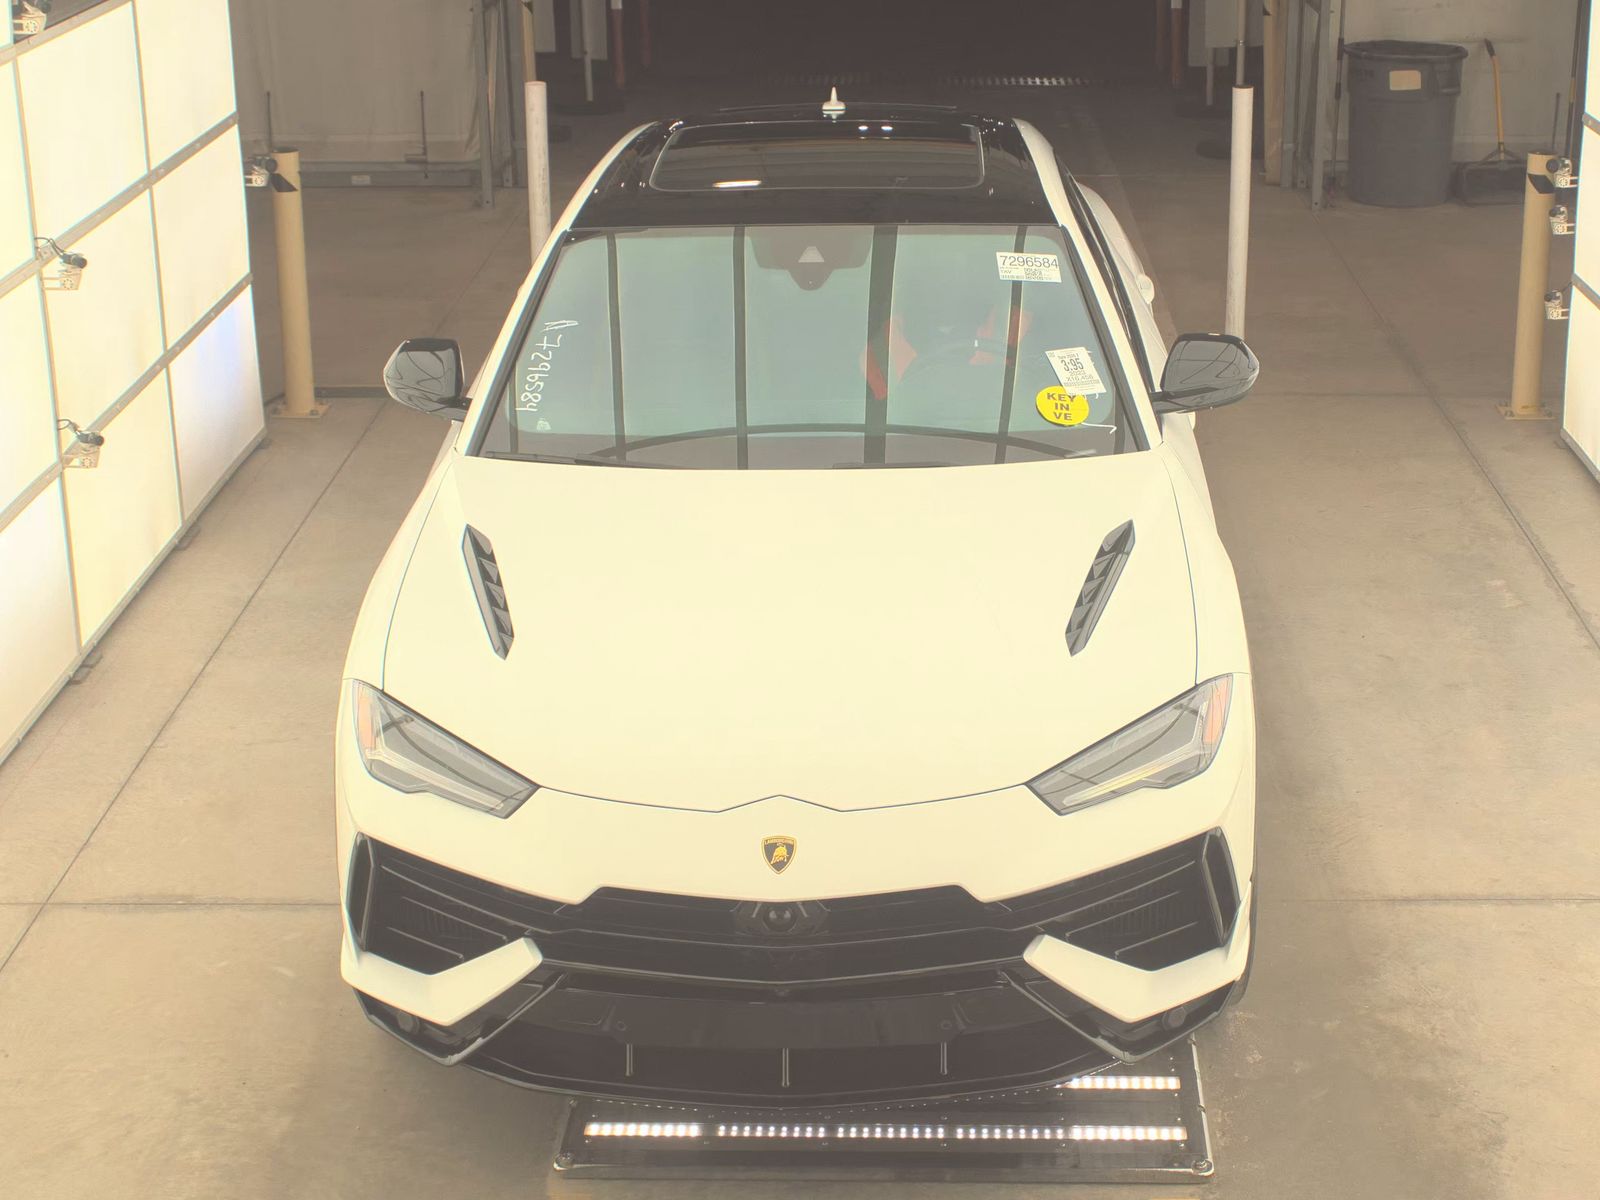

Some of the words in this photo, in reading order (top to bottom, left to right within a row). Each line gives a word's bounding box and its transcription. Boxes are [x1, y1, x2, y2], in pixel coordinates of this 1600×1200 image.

[1000, 255, 1058, 269] 7296584
[1046, 392, 1077, 403] KEY
[1054, 402, 1070, 412] IN
[1052, 411, 1073, 422] VE
